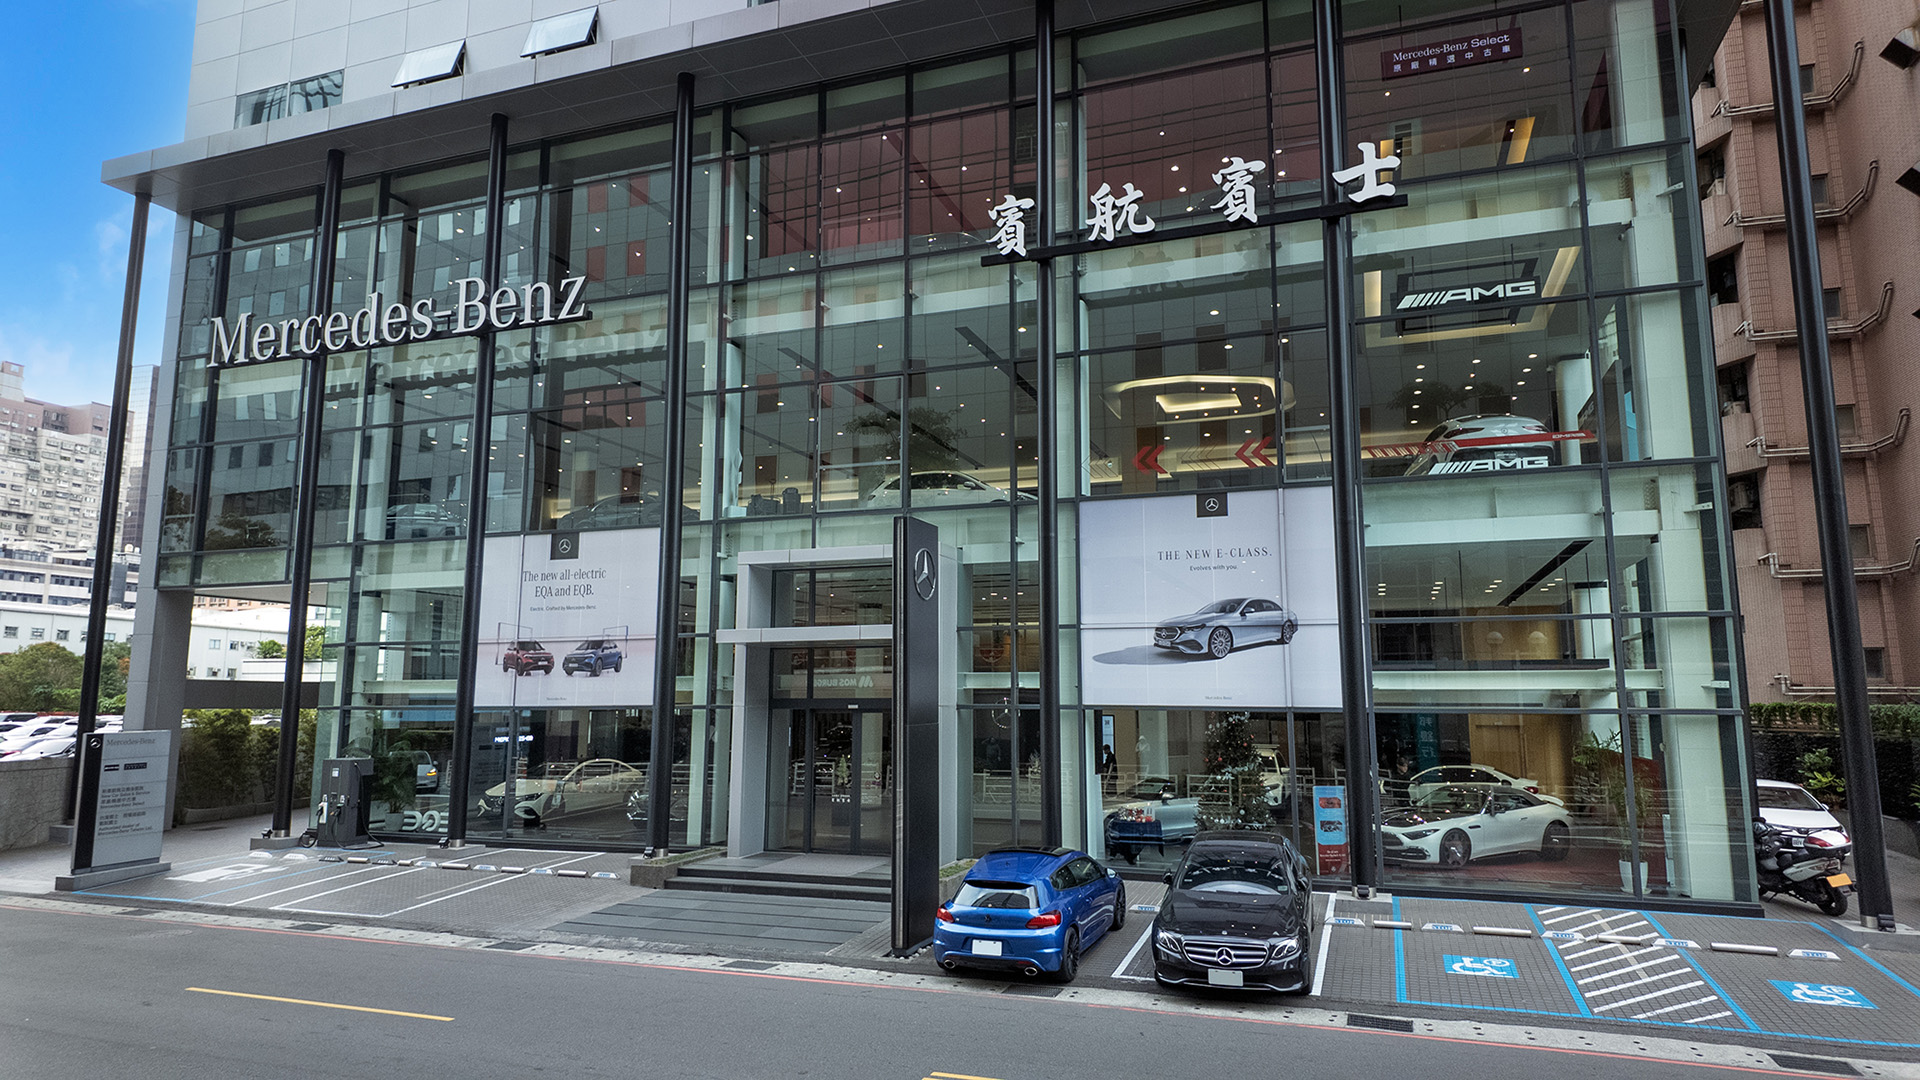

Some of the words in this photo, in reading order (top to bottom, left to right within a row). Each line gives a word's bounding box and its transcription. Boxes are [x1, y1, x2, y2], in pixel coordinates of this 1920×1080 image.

[1393, 41, 1468, 62] Mercedes-Benz
[1471, 34, 1510, 48] Select
[985, 142, 1400, 258] 賓航賓士
[1440, 281, 1536, 304] AMG
[207, 275, 588, 368] Mercedes-Benz
[1461, 456, 1548, 475] AMG
[1158, 550, 1180, 560] THE
[1186, 549, 1212, 560] NEW
[1216, 546, 1272, 558] E-CLASS.
[523, 570, 539, 582] The
[540, 572, 558, 582] new
[560, 568, 607, 580] all-electric
[534, 586, 553, 599] EQA
[554, 585, 570, 596] and
[573, 584, 594, 598] EQB.
